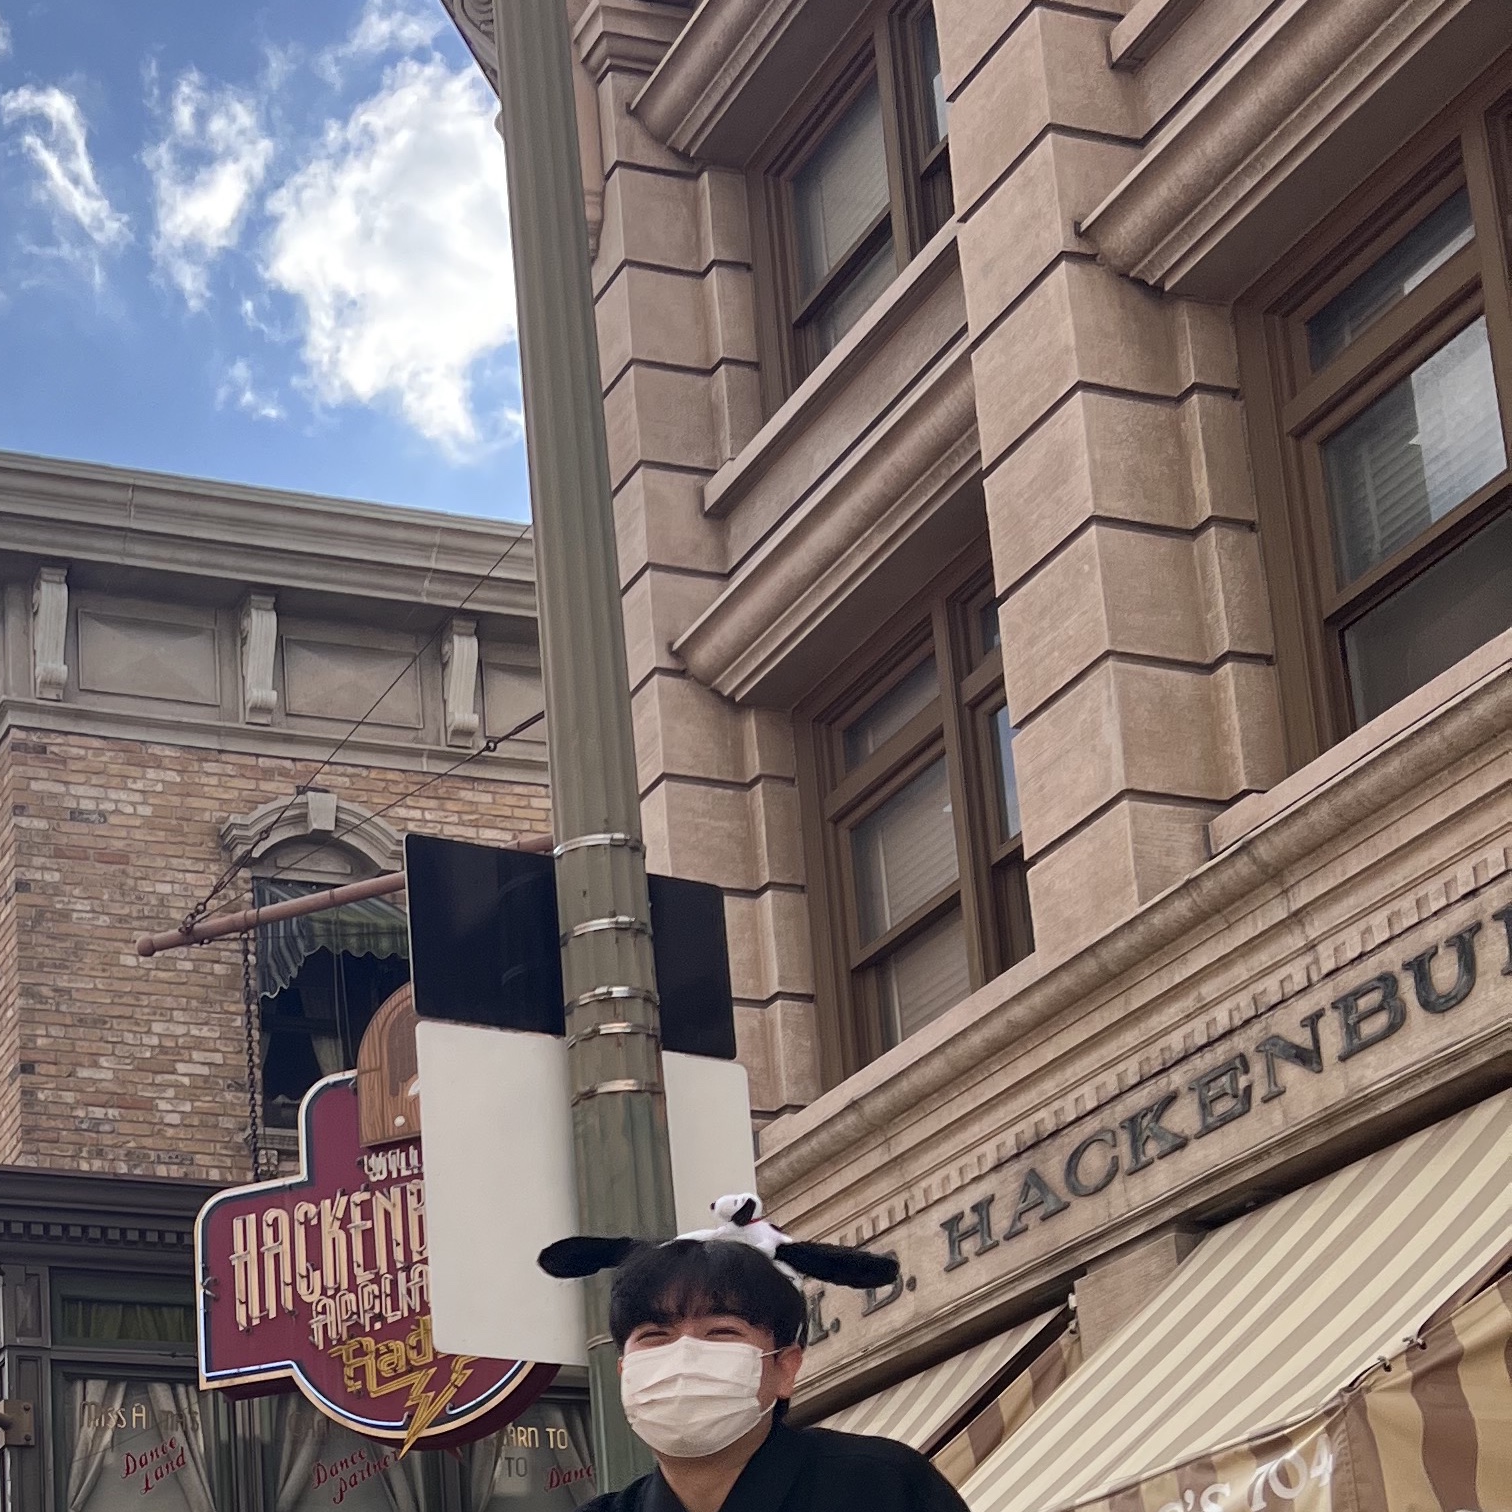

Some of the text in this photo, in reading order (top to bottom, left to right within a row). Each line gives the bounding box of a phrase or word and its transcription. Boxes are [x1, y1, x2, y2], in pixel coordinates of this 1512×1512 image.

[229, 1178, 430, 1331] HACKENB
[308, 1263, 433, 1350] APPLIA
[328, 1315, 433, 1397] Rad
[120, 1436, 178, 1480] Dance
[546, 1427, 568, 1449] TO
[141, 1447, 187, 1495] Land
[312, 1448, 367, 1490] Dance
[545, 1464, 594, 1492] Danc
